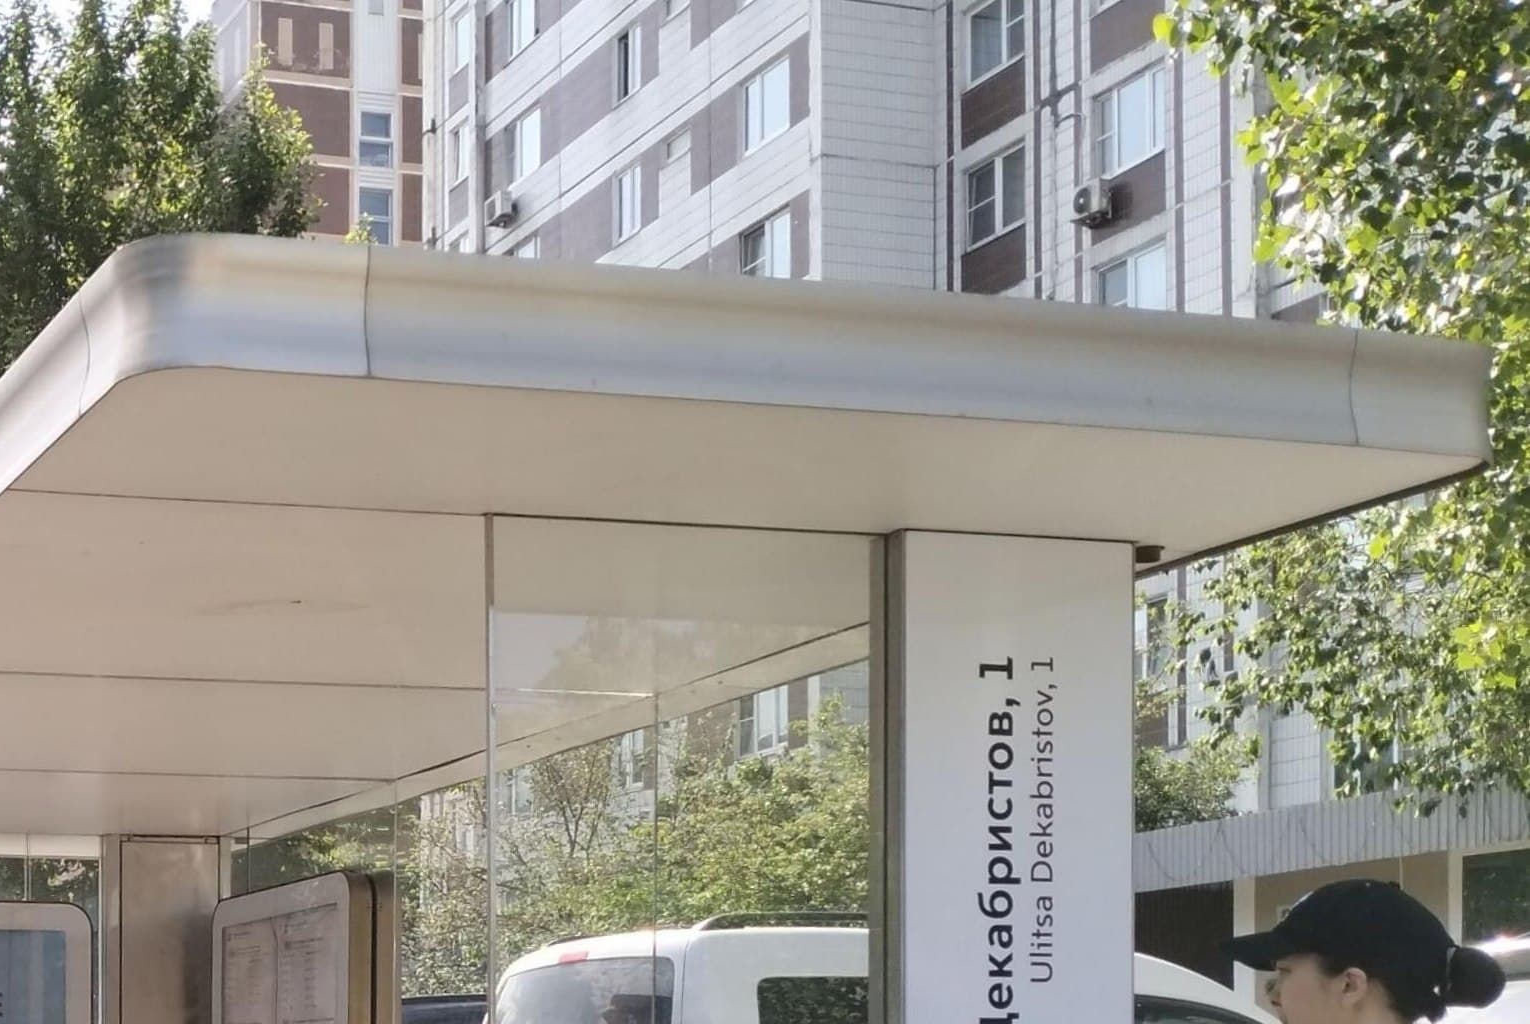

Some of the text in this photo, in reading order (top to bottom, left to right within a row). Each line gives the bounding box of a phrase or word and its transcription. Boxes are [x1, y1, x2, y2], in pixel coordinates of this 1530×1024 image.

[978, 655, 1014, 681] 1
[1029, 656, 1058, 983] Ulitsa Dekabristov, 1
